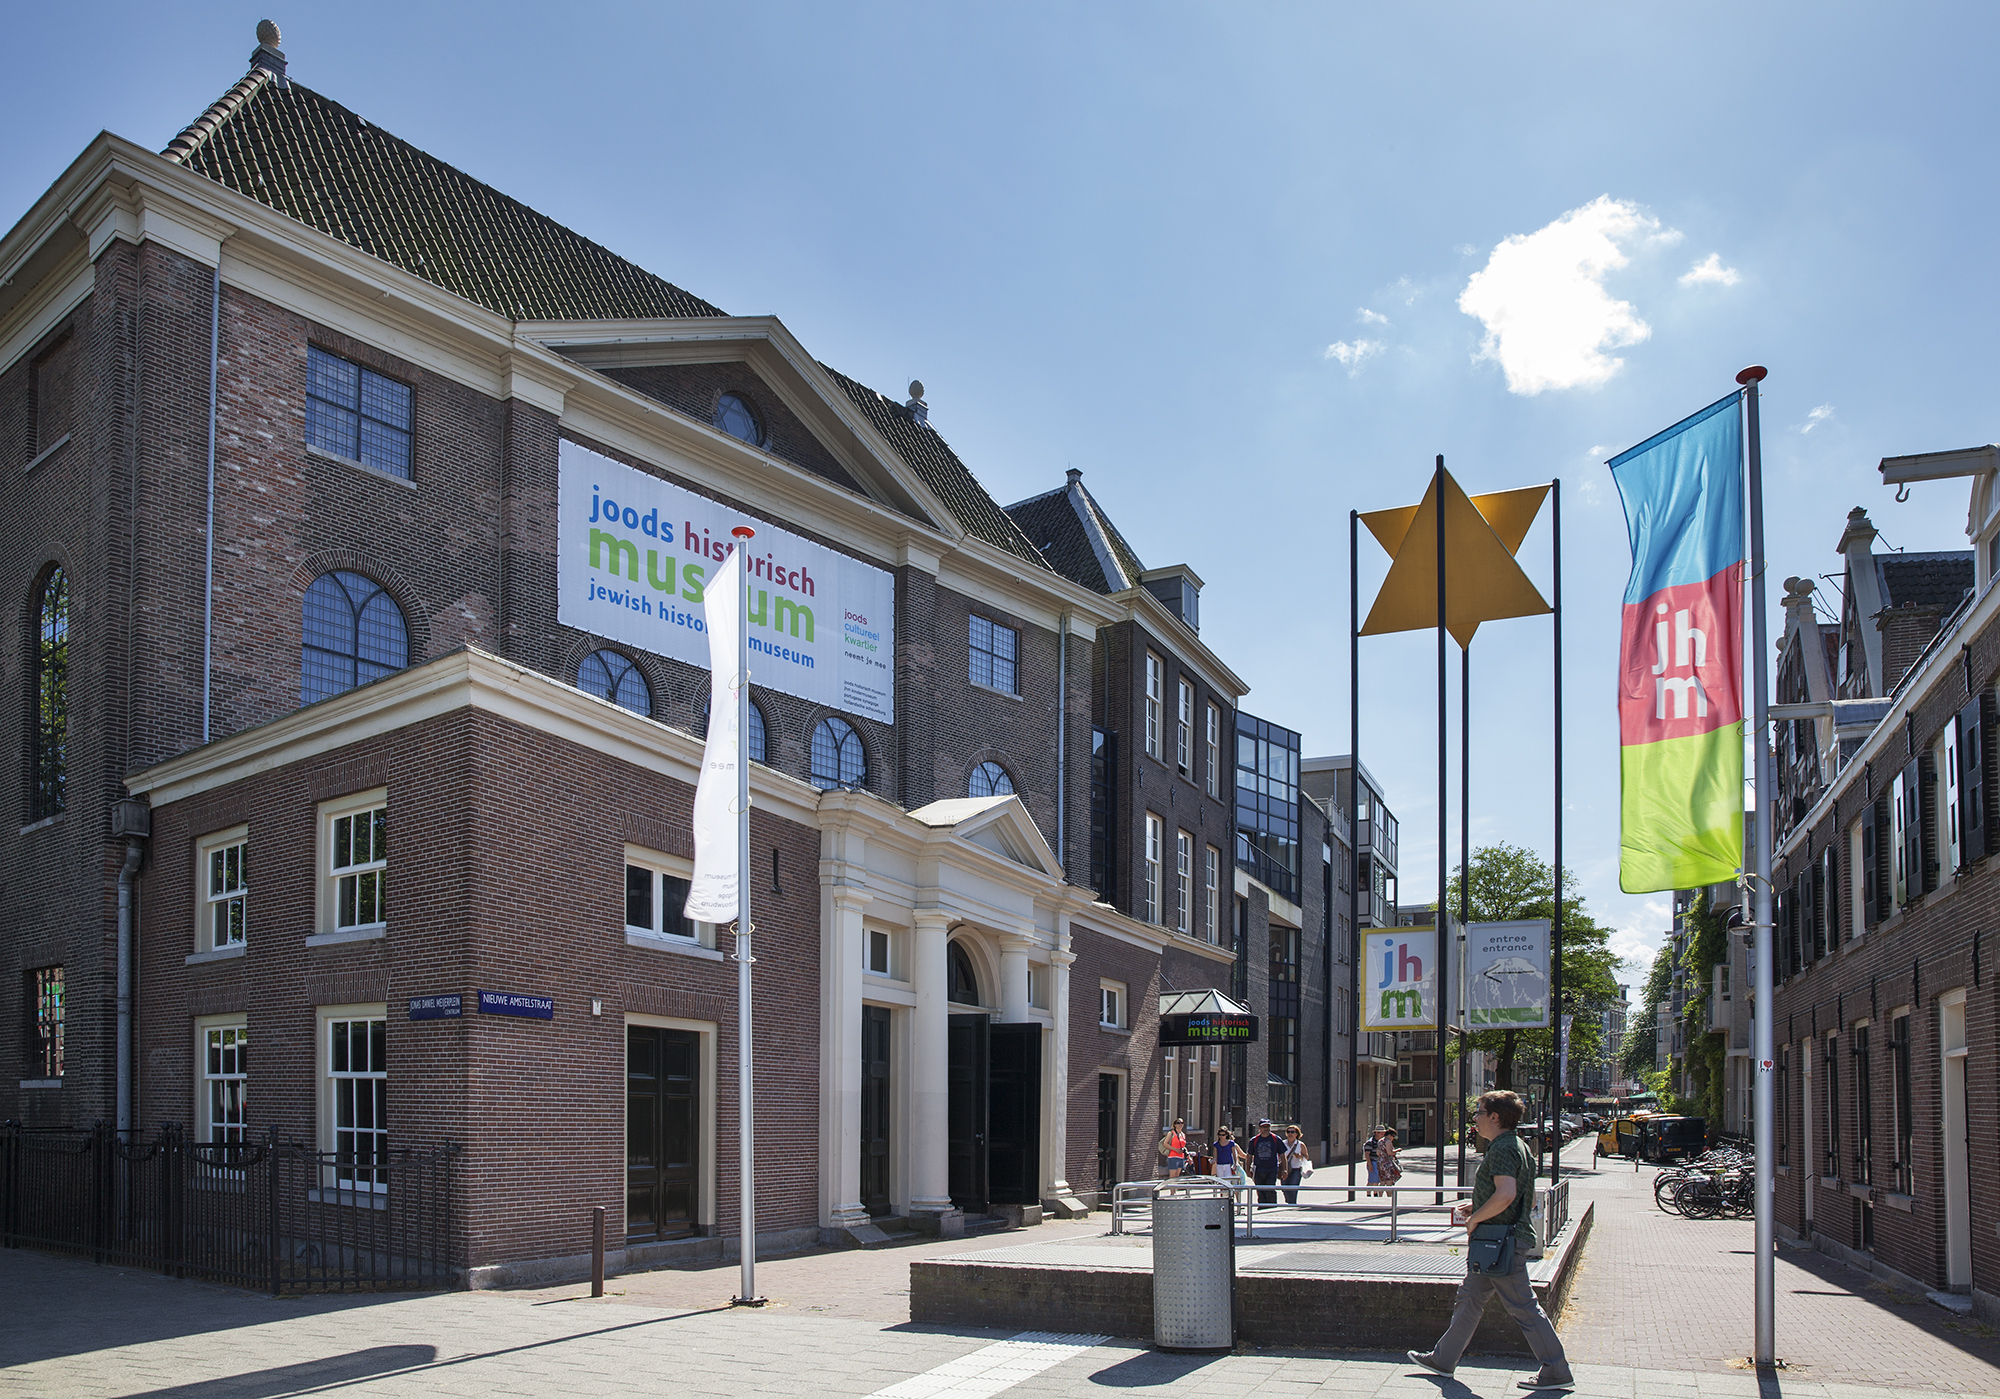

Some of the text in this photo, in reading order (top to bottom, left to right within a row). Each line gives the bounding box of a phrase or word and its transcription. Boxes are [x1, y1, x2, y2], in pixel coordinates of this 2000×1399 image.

[588, 484, 674, 543] joods
[589, 528, 815, 643] musum
[588, 577, 652, 615] jewish
[748, 636, 814, 669] museum
[844, 608, 868, 625] joods
[844, 623, 880, 641] cultureel
[844, 633, 878, 653] kwartier
[844, 651, 887, 670] neemt je mee
[1489, 935, 1527, 943] entree
[1482, 944, 1534, 953] entrance
[483, 993, 552, 1010] NIEUWE AMSTELSTRAAT
[1188, 1018, 1249, 1028] joods historisch
[1188, 1027, 1249, 1037] museum
